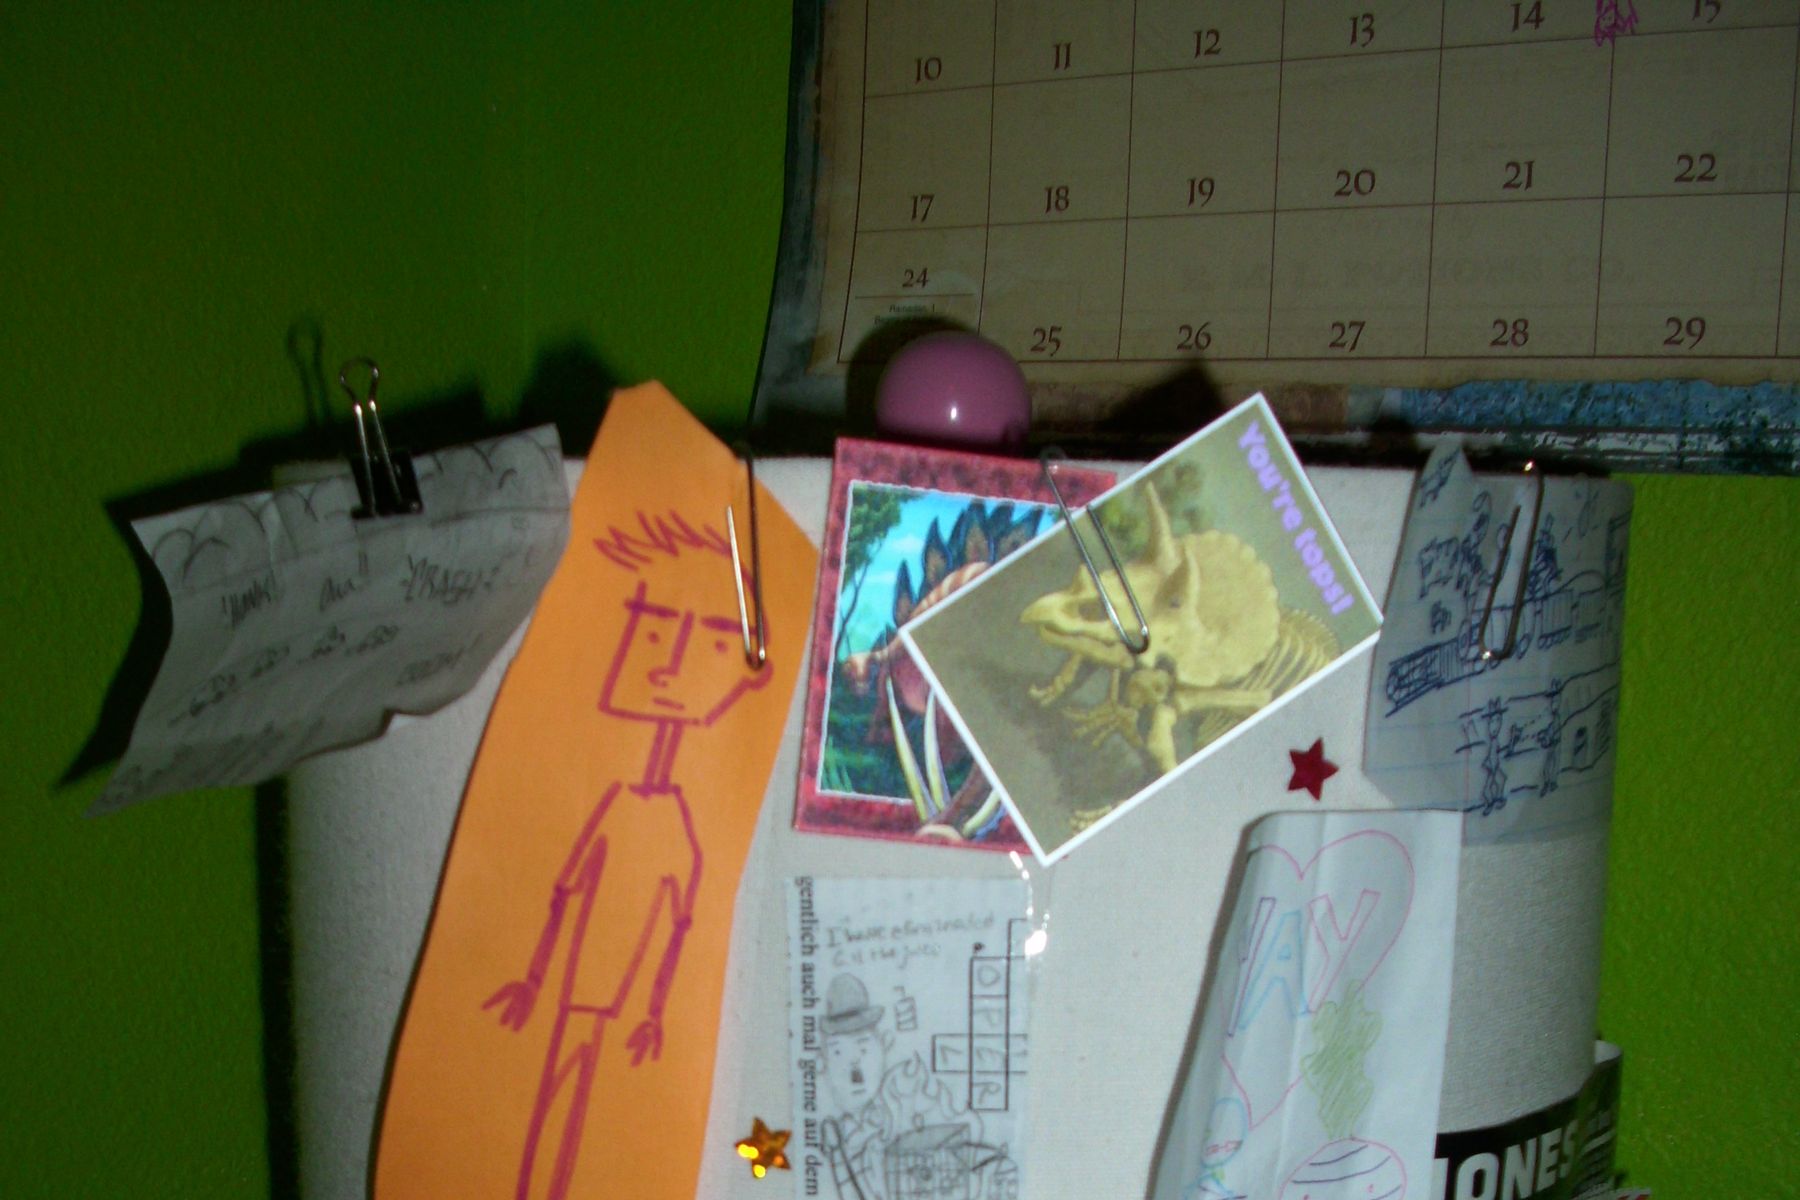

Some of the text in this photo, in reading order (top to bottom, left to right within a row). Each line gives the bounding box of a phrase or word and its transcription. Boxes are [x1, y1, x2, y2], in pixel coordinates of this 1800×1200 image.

[1349, 13, 1375, 47] 13
[1511, 0, 1545, 32] 14
[1053, 42, 1072, 70] 11
[1194, 29, 1221, 58] 12
[915, 57, 942, 83] 10
[1334, 169, 1376, 197] 20
[1502, 160, 1535, 191] 21
[1674, 153, 1718, 183] 22
[1045, 186, 1070, 214] 18
[1187, 177, 1215, 207] 19
[911, 194, 935, 222] 17
[902, 268, 930, 289] 24
[1030, 327, 1063, 357] 25
[1177, 322, 1212, 351] 26
[1329, 321, 1366, 352] 27
[1490, 318, 1529, 347] 28
[1663, 317, 1707, 350] 29
[1238, 420, 1355, 616] You're tops!
[795, 876, 819, 957] gentlich
[802, 962, 820, 1009] auch
[803, 1016, 822, 1051] mal
[798, 1059, 817, 1112] gerne
[804, 1117, 823, 1148] auf
[805, 1156, 822, 1196] dem
